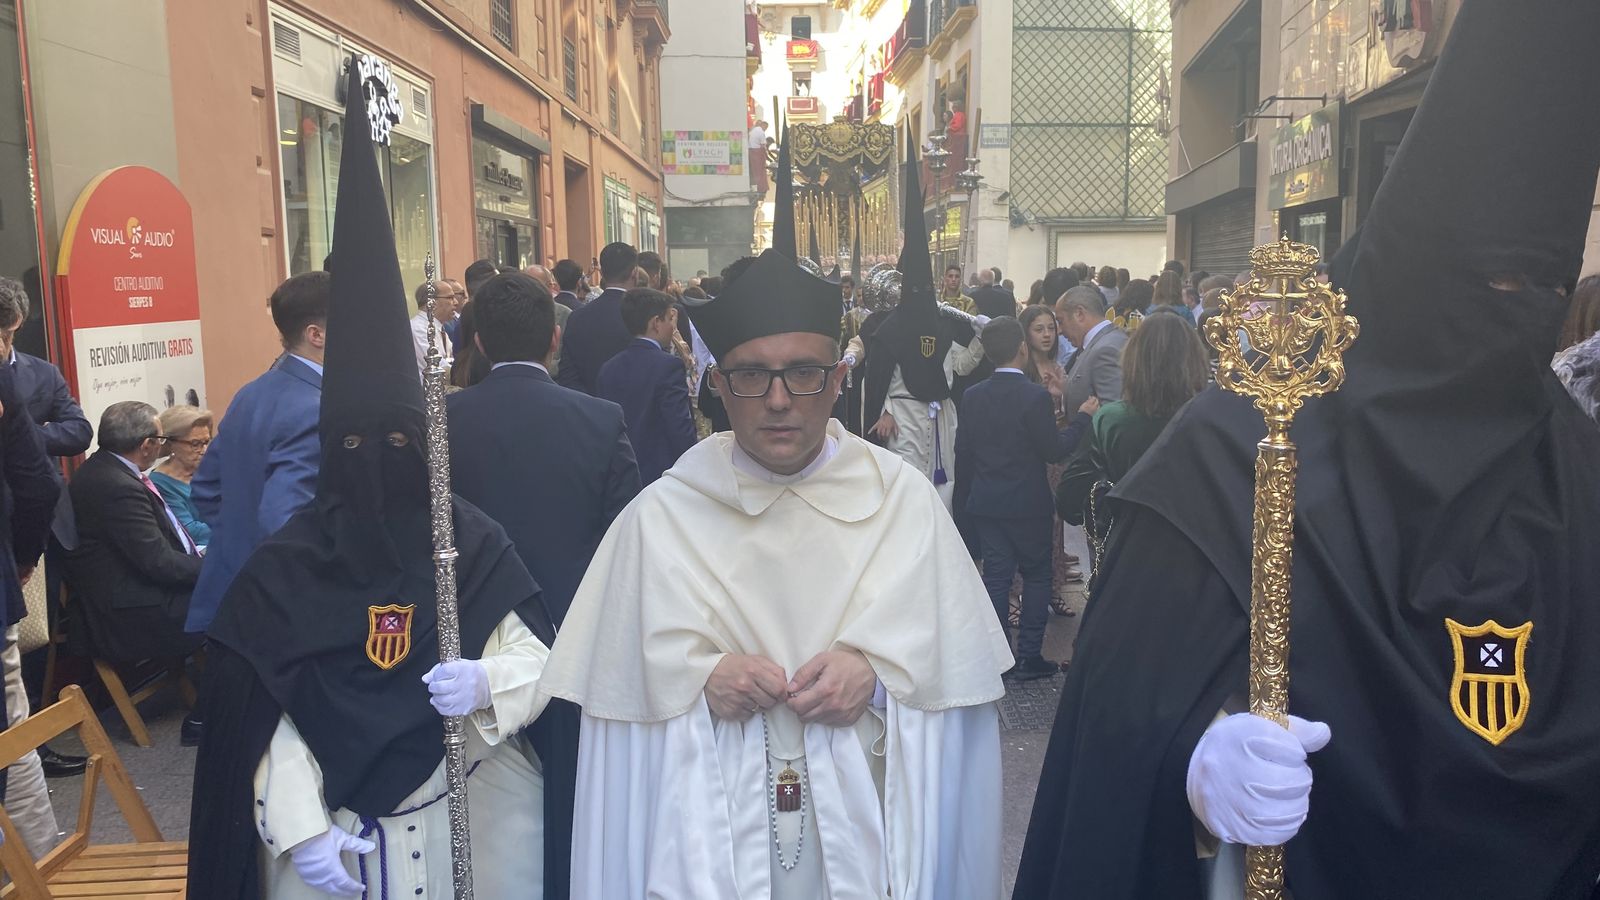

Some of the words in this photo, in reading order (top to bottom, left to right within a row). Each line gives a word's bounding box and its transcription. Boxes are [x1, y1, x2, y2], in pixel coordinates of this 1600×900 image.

[91, 228, 126, 245] VISUAL
[144, 231, 174, 247] AUDIO
[113, 276, 137, 291] CENTRO
[138, 276, 164, 290] AUDITIVO
[128, 296, 148, 308] SIERPES
[89, 341, 130, 368] REVISIÓN
[131, 340, 167, 362] AUDITIVA
[167, 337, 194, 358] GRATIS
